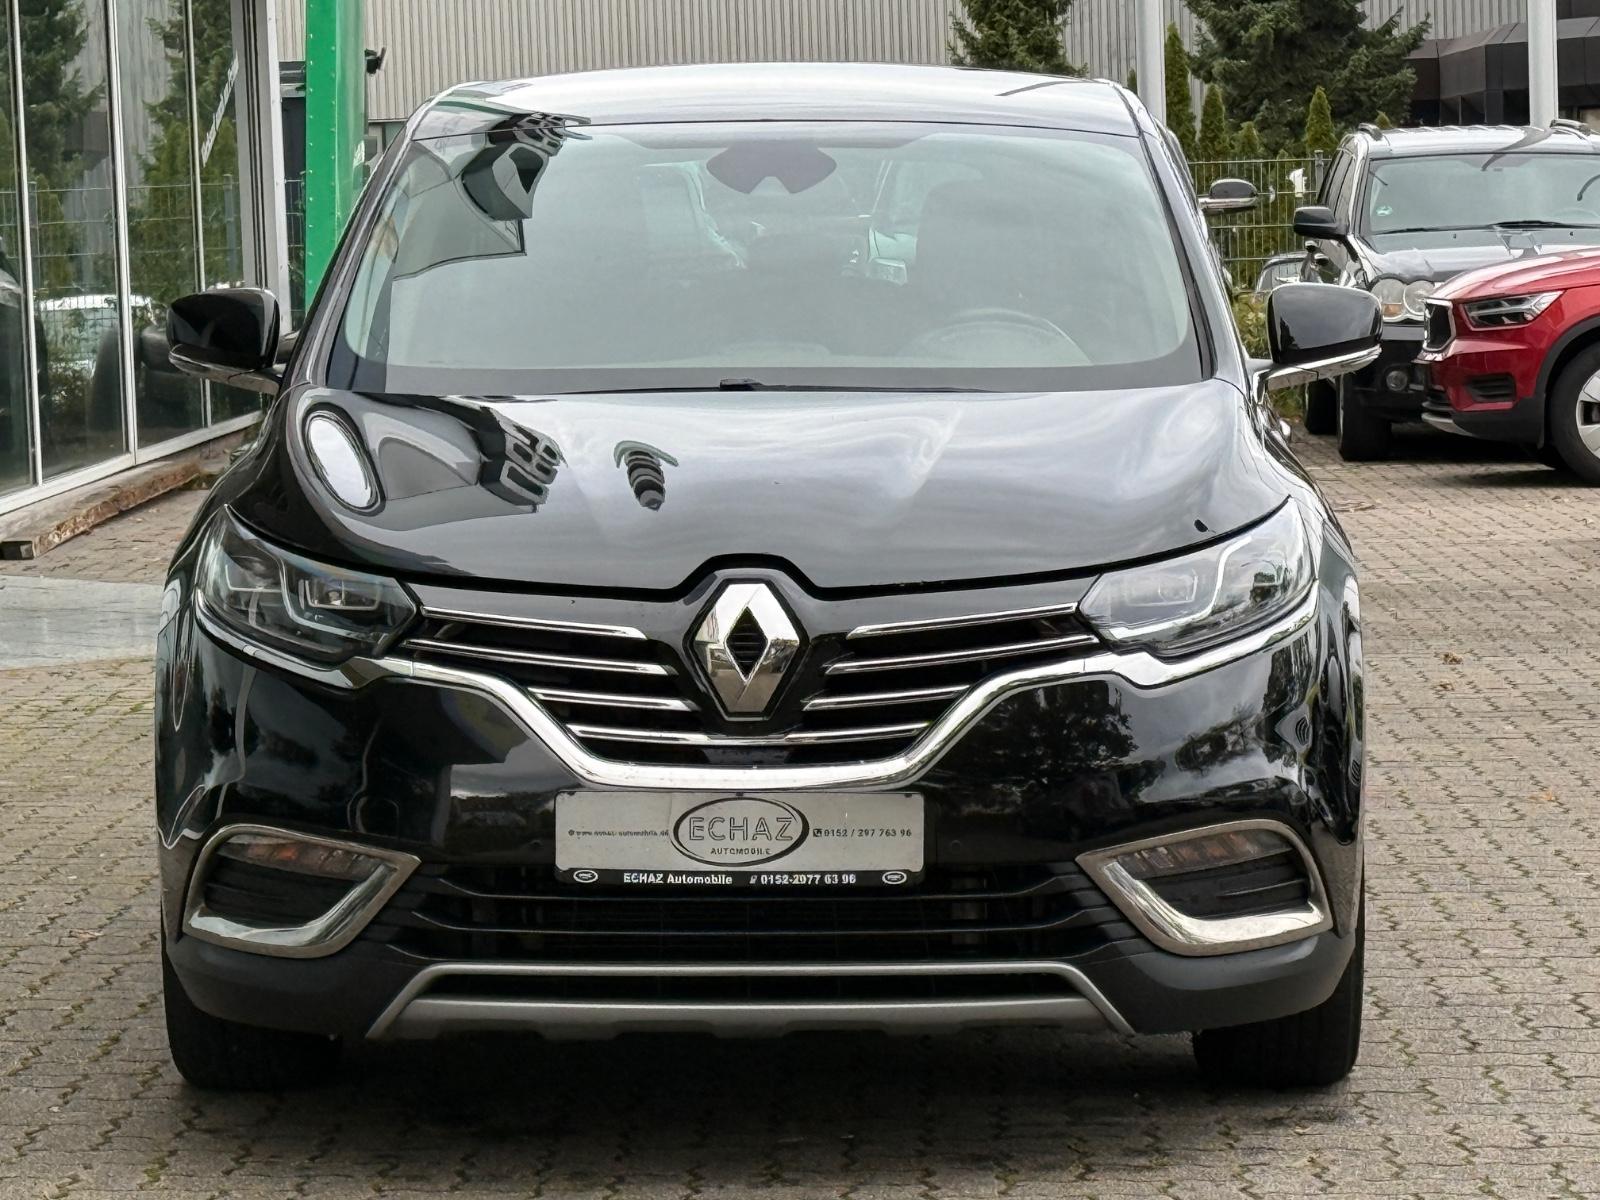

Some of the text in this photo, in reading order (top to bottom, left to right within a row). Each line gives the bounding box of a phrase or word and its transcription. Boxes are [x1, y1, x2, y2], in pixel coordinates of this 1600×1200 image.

[689, 816, 793, 840] ECHAZ
[710, 847, 772, 855] AUTOMOBILE
[623, 872, 664, 884] ECHAZ
[667, 873, 733, 885] Automobile
